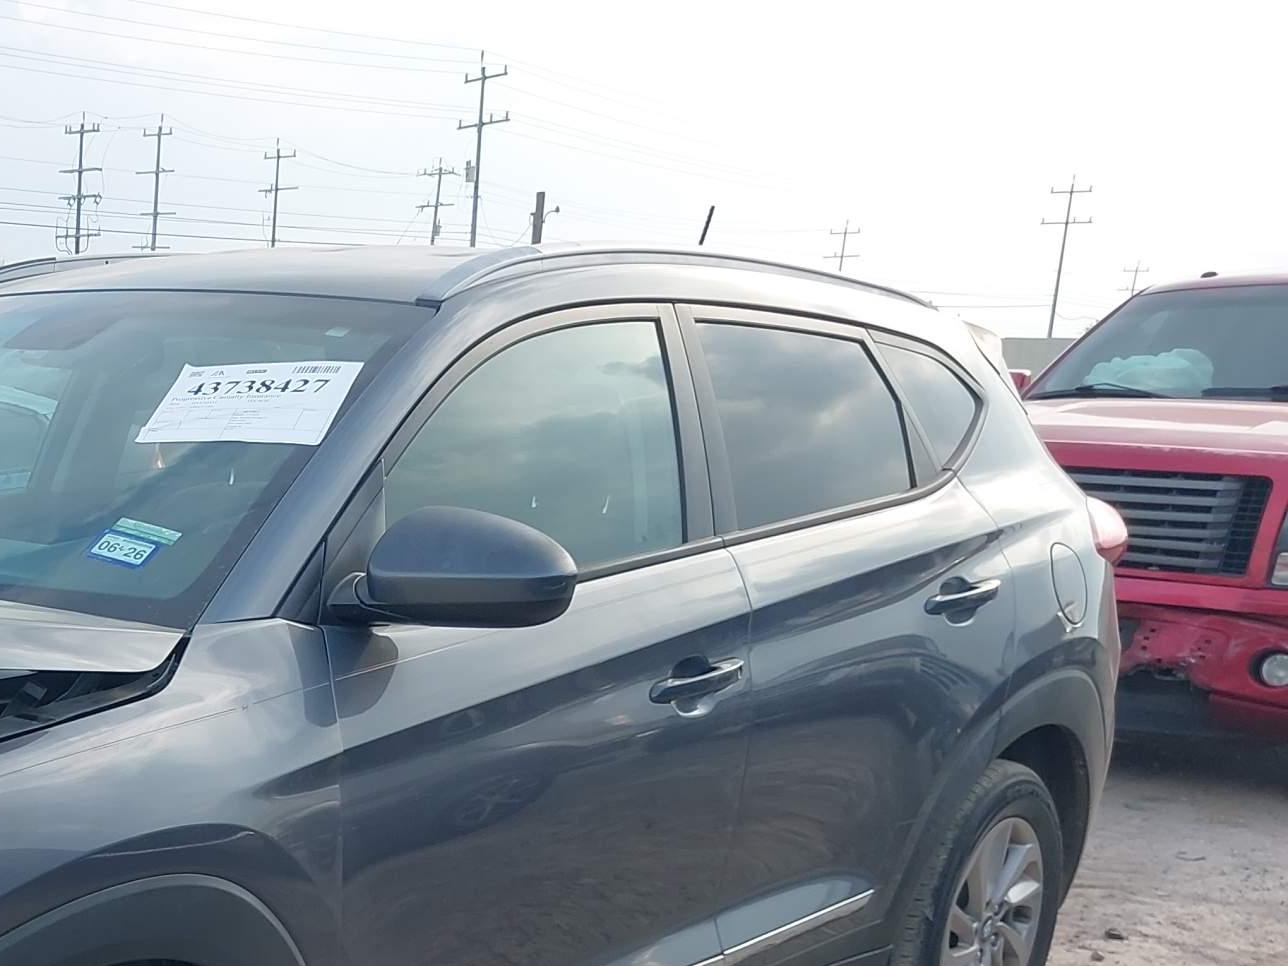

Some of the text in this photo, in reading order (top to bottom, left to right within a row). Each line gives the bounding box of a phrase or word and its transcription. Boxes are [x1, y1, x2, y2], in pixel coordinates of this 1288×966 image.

[187, 379, 331, 396] 43738427
[98, 540, 121, 553] 06
[123, 546, 147, 560] 26
